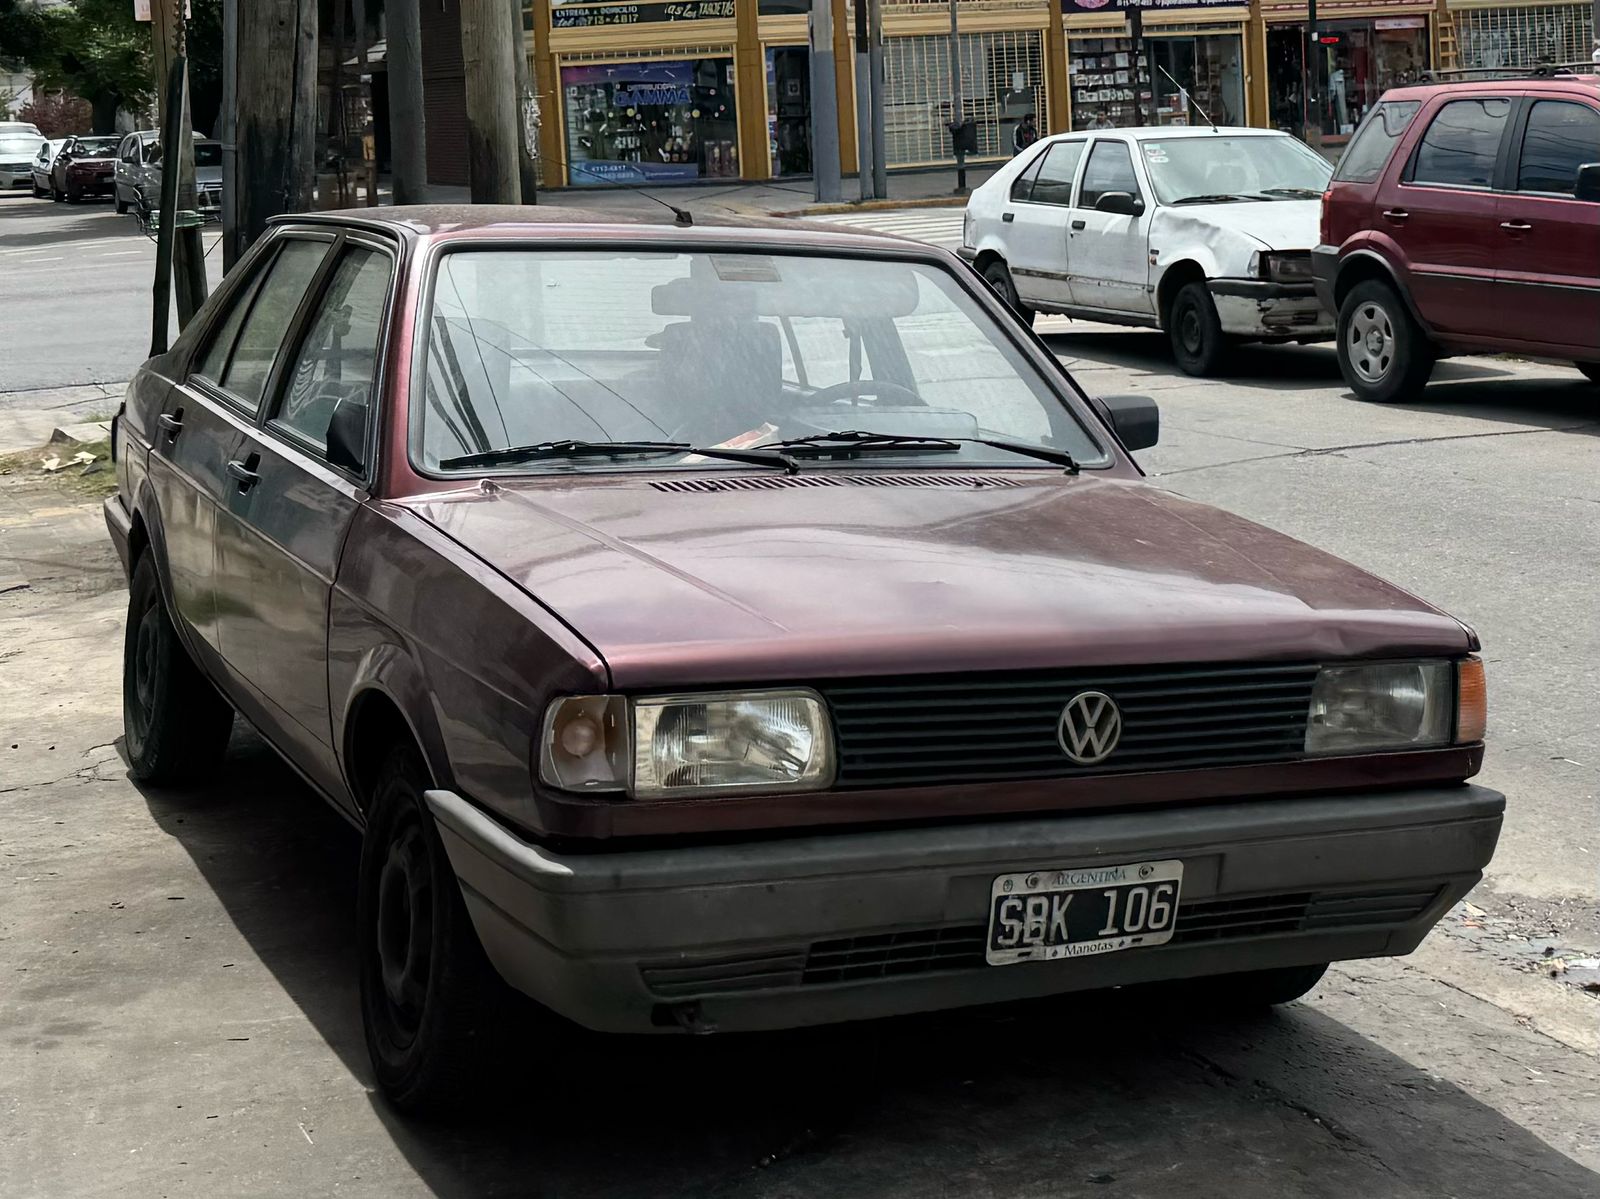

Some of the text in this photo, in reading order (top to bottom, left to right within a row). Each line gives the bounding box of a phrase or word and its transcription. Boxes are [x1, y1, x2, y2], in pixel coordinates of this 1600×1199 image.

[614, 87, 692, 107] GAMMA
[1058, 690, 1122, 763] VW
[1052, 867, 1127, 886] ARGENTINA
[997, 884, 1173, 947] SBK 106
[1064, 941, 1113, 957] Manotas
